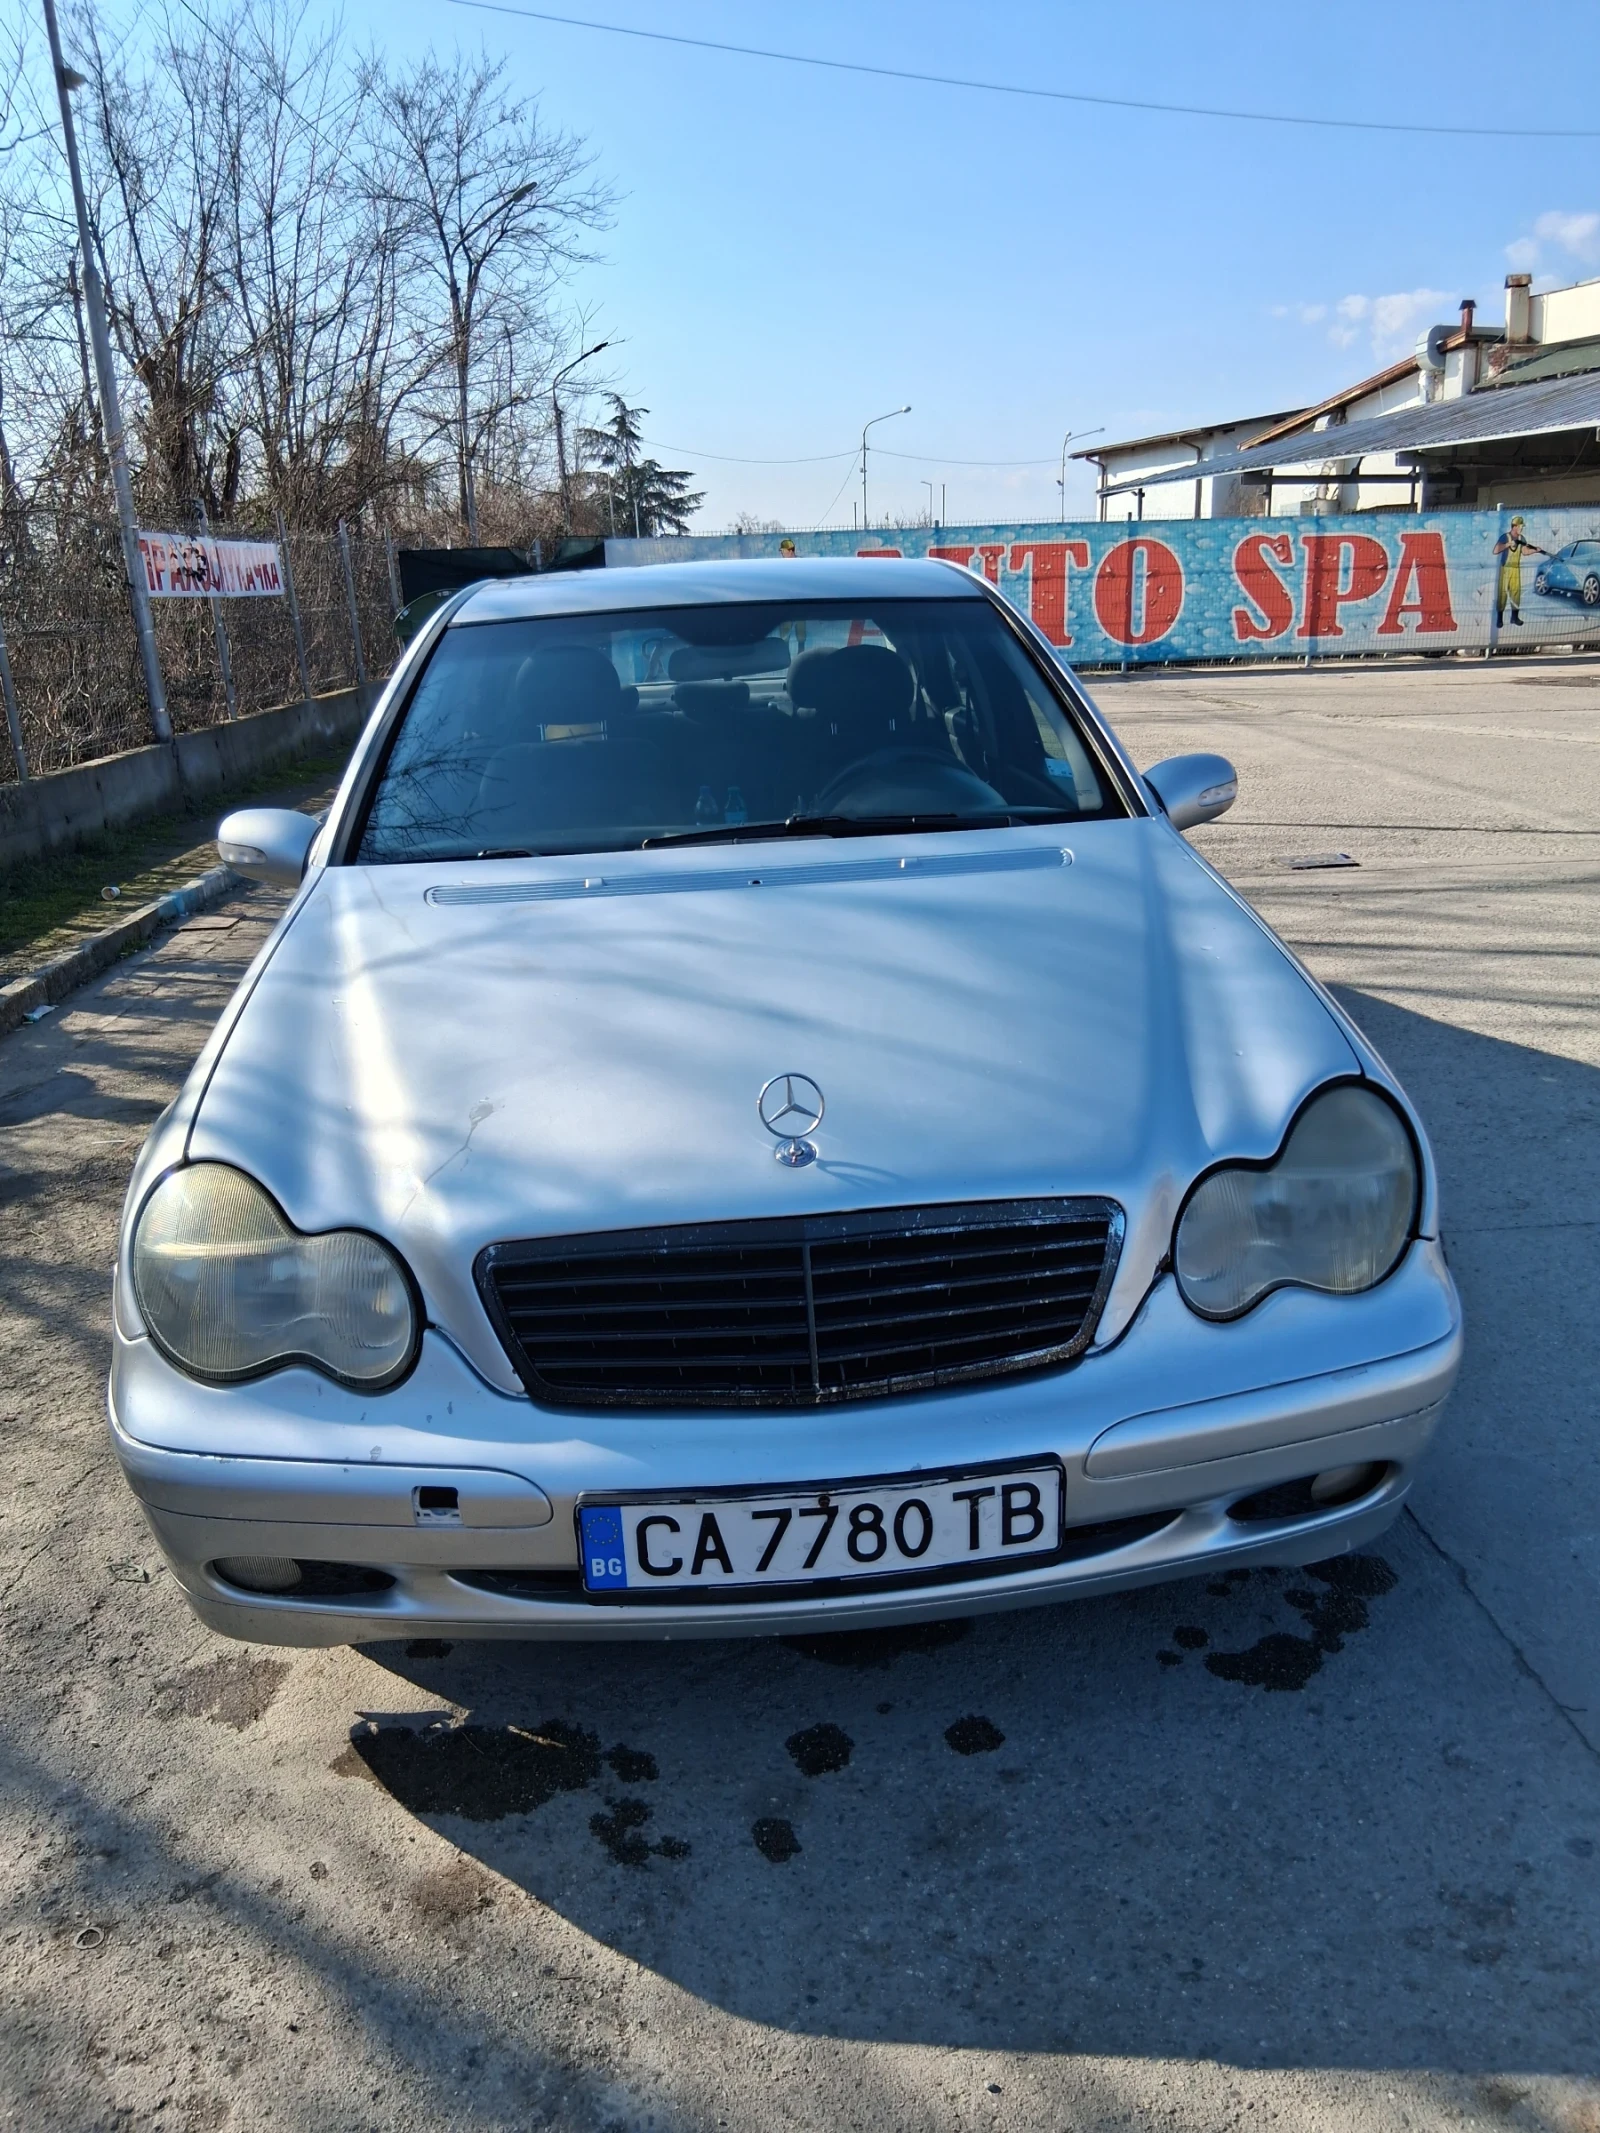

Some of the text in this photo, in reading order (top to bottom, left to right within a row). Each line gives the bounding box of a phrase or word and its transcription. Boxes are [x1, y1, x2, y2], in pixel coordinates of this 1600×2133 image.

[848, 532, 1458, 646] TO SPA
[592, 1558, 622, 1577] BG
[636, 1482, 1044, 1577] CA 7780 TB
